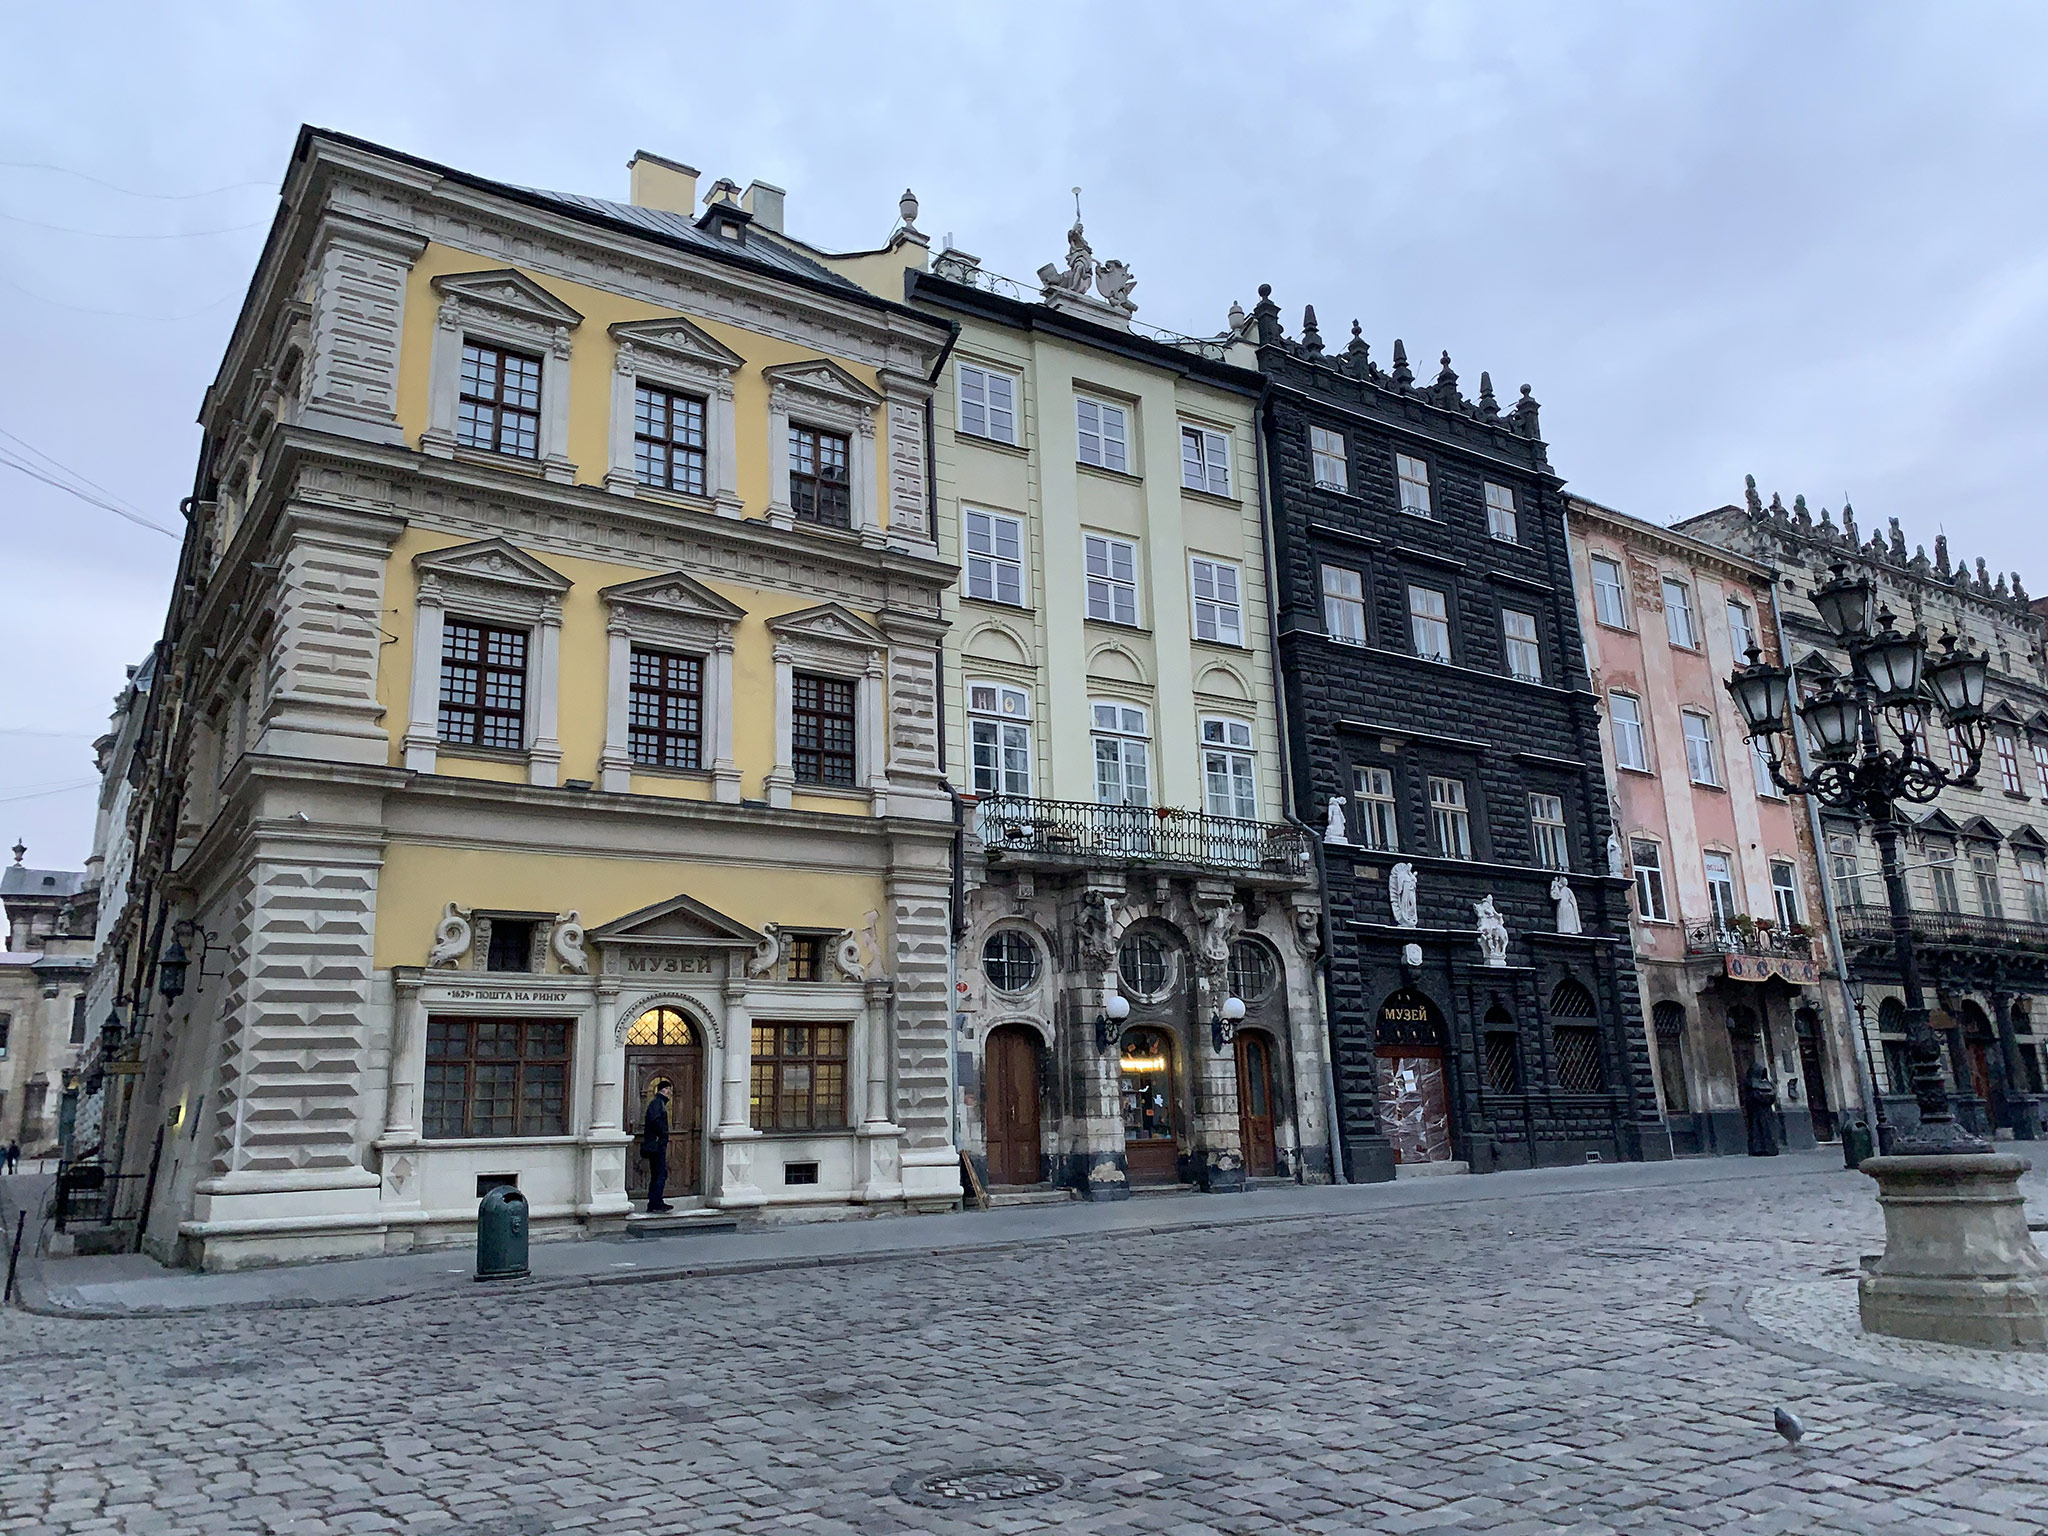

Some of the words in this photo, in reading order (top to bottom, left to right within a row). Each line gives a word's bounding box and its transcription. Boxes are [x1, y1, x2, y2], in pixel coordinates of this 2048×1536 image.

[627, 955, 713, 974] МУЗЕЙ
[475, 991, 513, 1000] ПОШТА
[515, 992, 530, 1001] НА
[532, 992, 568, 1002] РИНКУ
[1385, 1005, 1428, 1022] МУЗЕЙ
